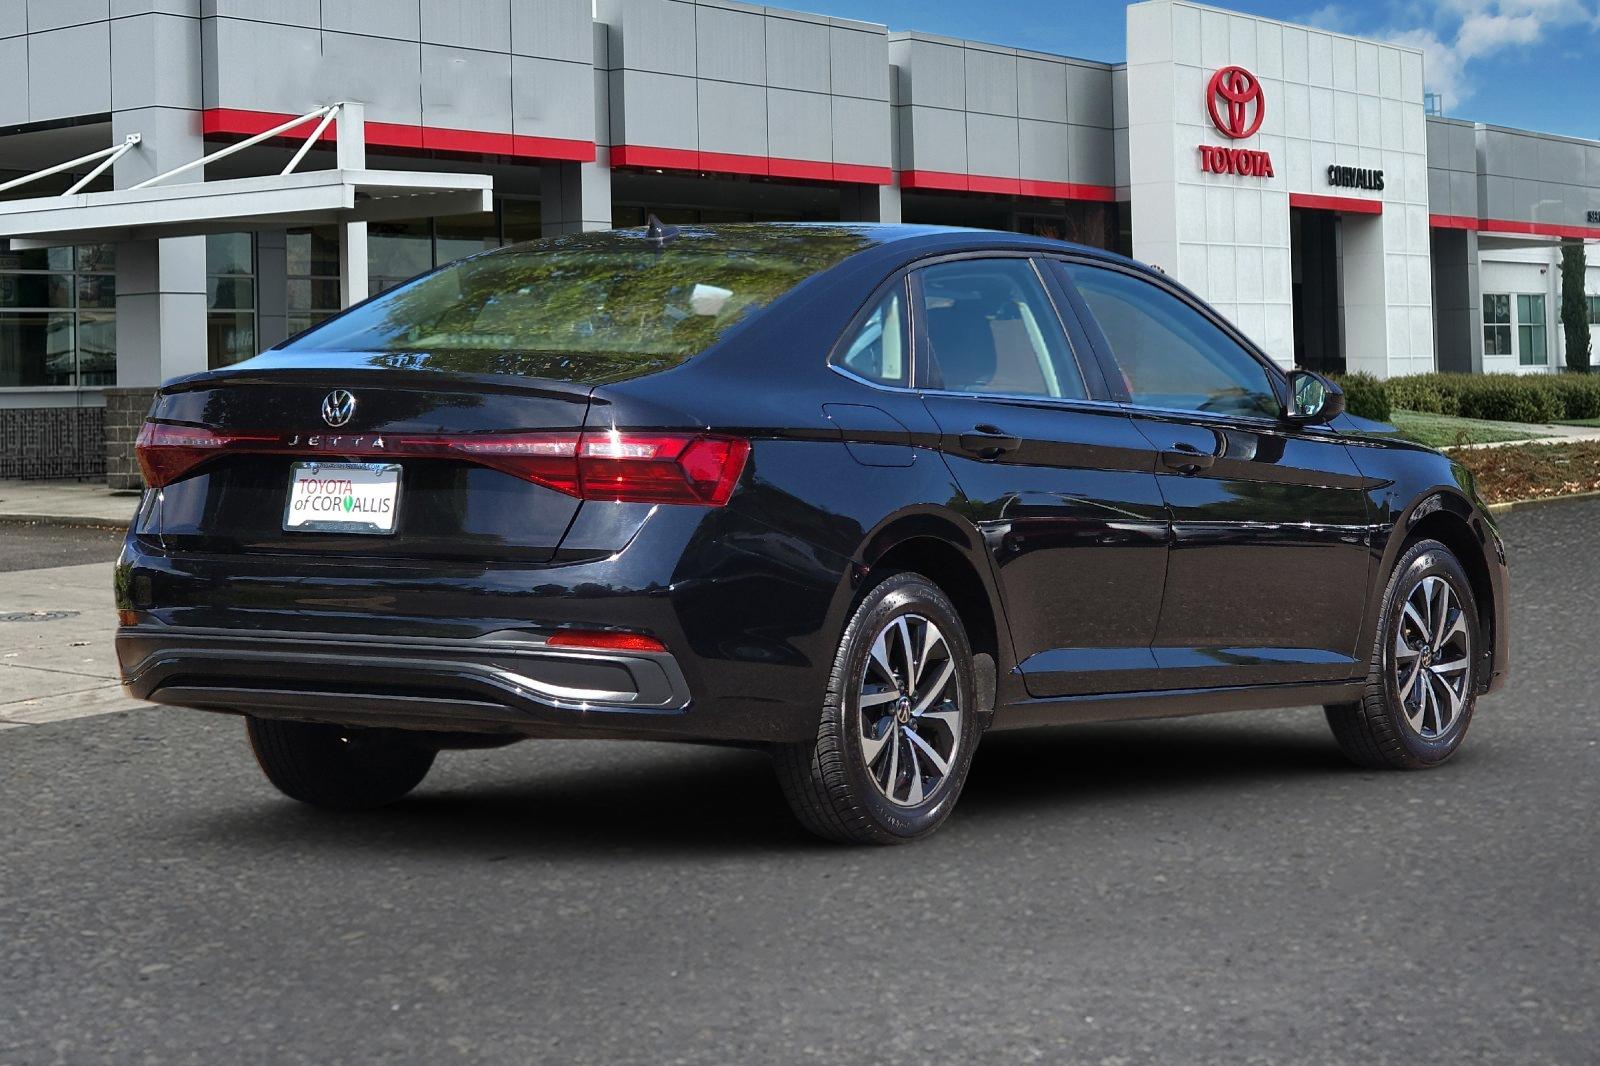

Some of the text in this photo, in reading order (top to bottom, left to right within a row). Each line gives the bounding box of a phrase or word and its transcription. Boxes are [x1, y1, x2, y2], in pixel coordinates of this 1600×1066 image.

[1198, 145, 1275, 178] TOYOTA
[1327, 164, 1385, 191] CORVALLIS
[288, 434, 385, 448] JETTA
[299, 478, 353, 495] TOYOTA
[294, 495, 311, 511] of
